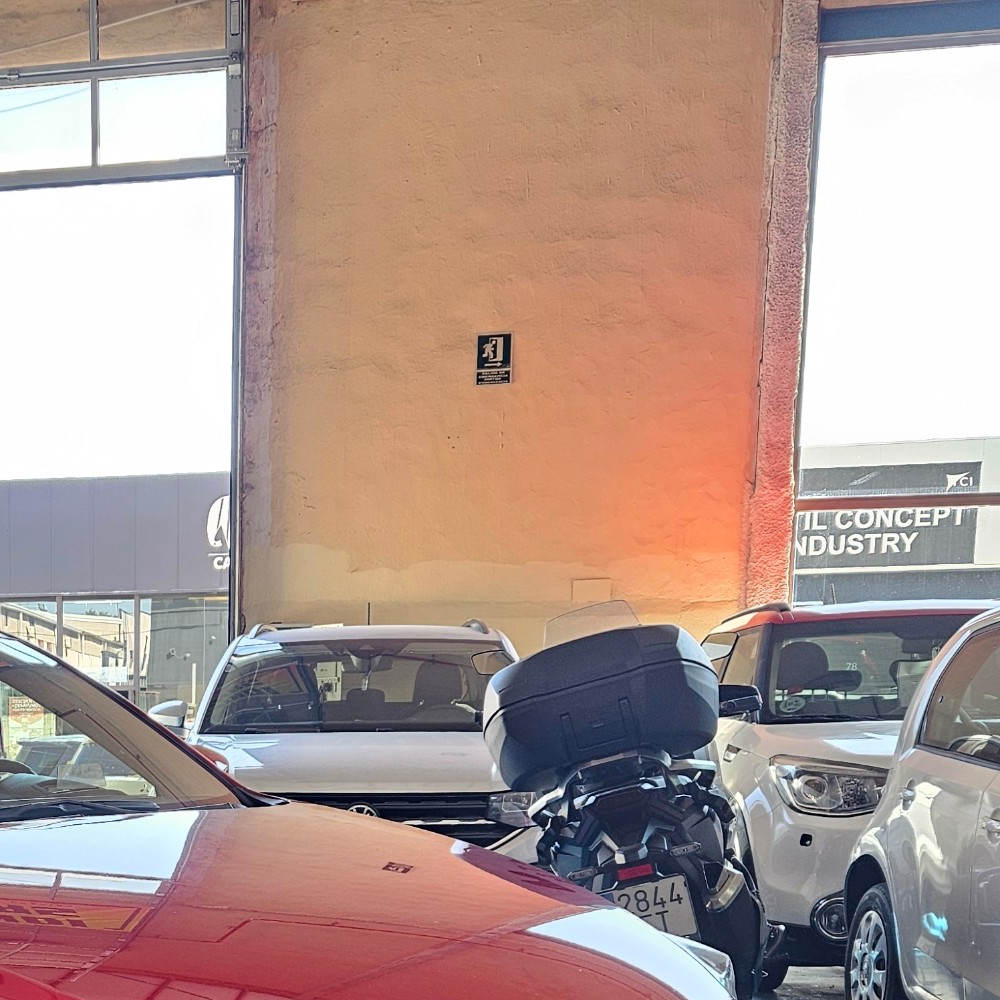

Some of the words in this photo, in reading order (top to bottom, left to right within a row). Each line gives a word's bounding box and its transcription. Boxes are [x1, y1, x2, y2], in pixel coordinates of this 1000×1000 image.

[798, 510, 828, 530] IL
[835, 507, 966, 530] CONCEPT
[796, 532, 919, 556] NDUSTRY
[617, 882, 684, 916] 2844
